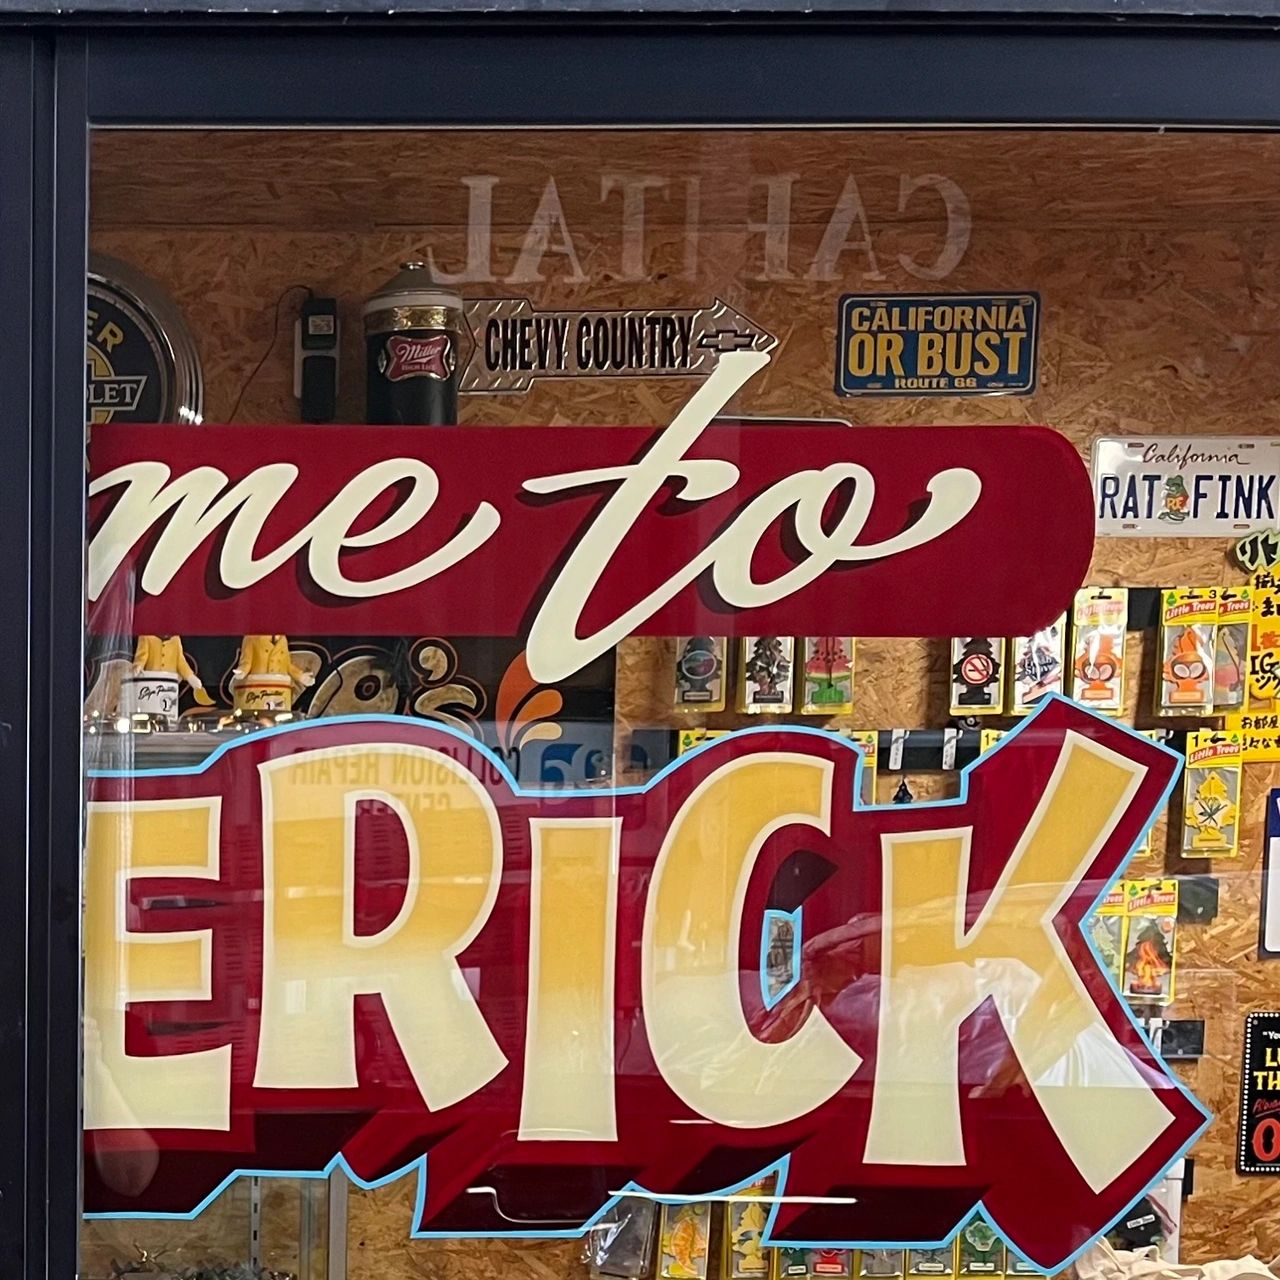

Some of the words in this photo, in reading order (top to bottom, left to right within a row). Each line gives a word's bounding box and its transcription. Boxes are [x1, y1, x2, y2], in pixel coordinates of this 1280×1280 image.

[851, 306, 1027, 331] CALIFORNIA
[396, 344, 442, 363] Miller
[485, 314, 568, 371] CHEVY
[576, 314, 696, 371] COUNTRY
[848, 331, 905, 377] OR
[917, 330, 1027, 377] BUST
[894, 377, 949, 389] ROUTE
[954, 377, 977, 388] 66
[1142, 443, 1251, 470] California
[1099, 474, 1162, 519] RAT
[1191, 474, 1277, 519] FINK
[522, 351, 982, 684] to
